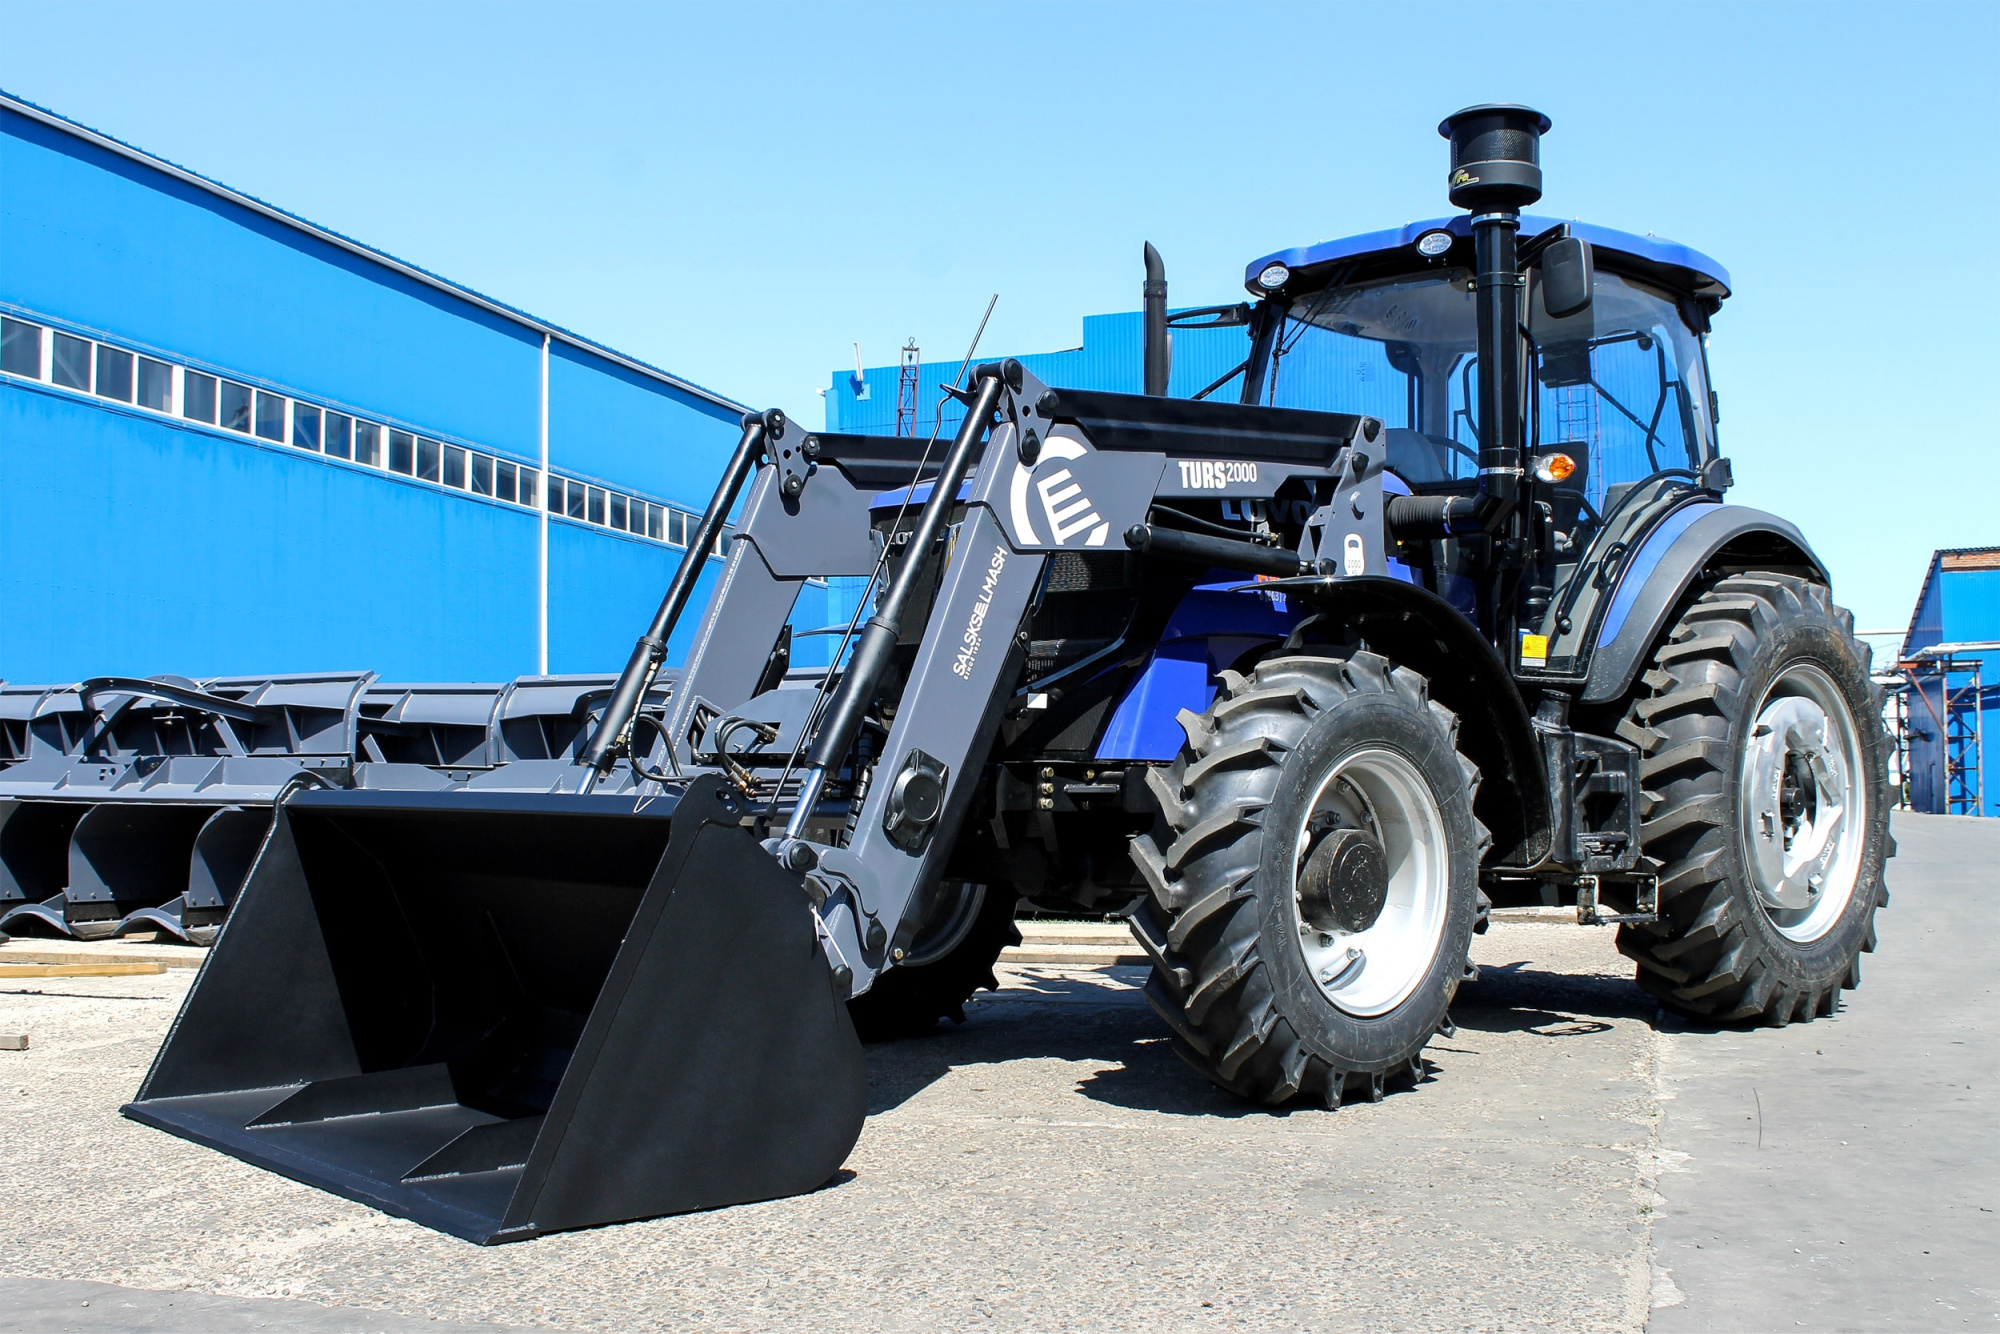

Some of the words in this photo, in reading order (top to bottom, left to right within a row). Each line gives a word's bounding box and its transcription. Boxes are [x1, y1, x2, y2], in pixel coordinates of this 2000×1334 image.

[1221, 499, 1312, 525] LOVO
[952, 545, 1009, 677] SALSKSELMASH
[963, 655, 976, 681] SINCE
